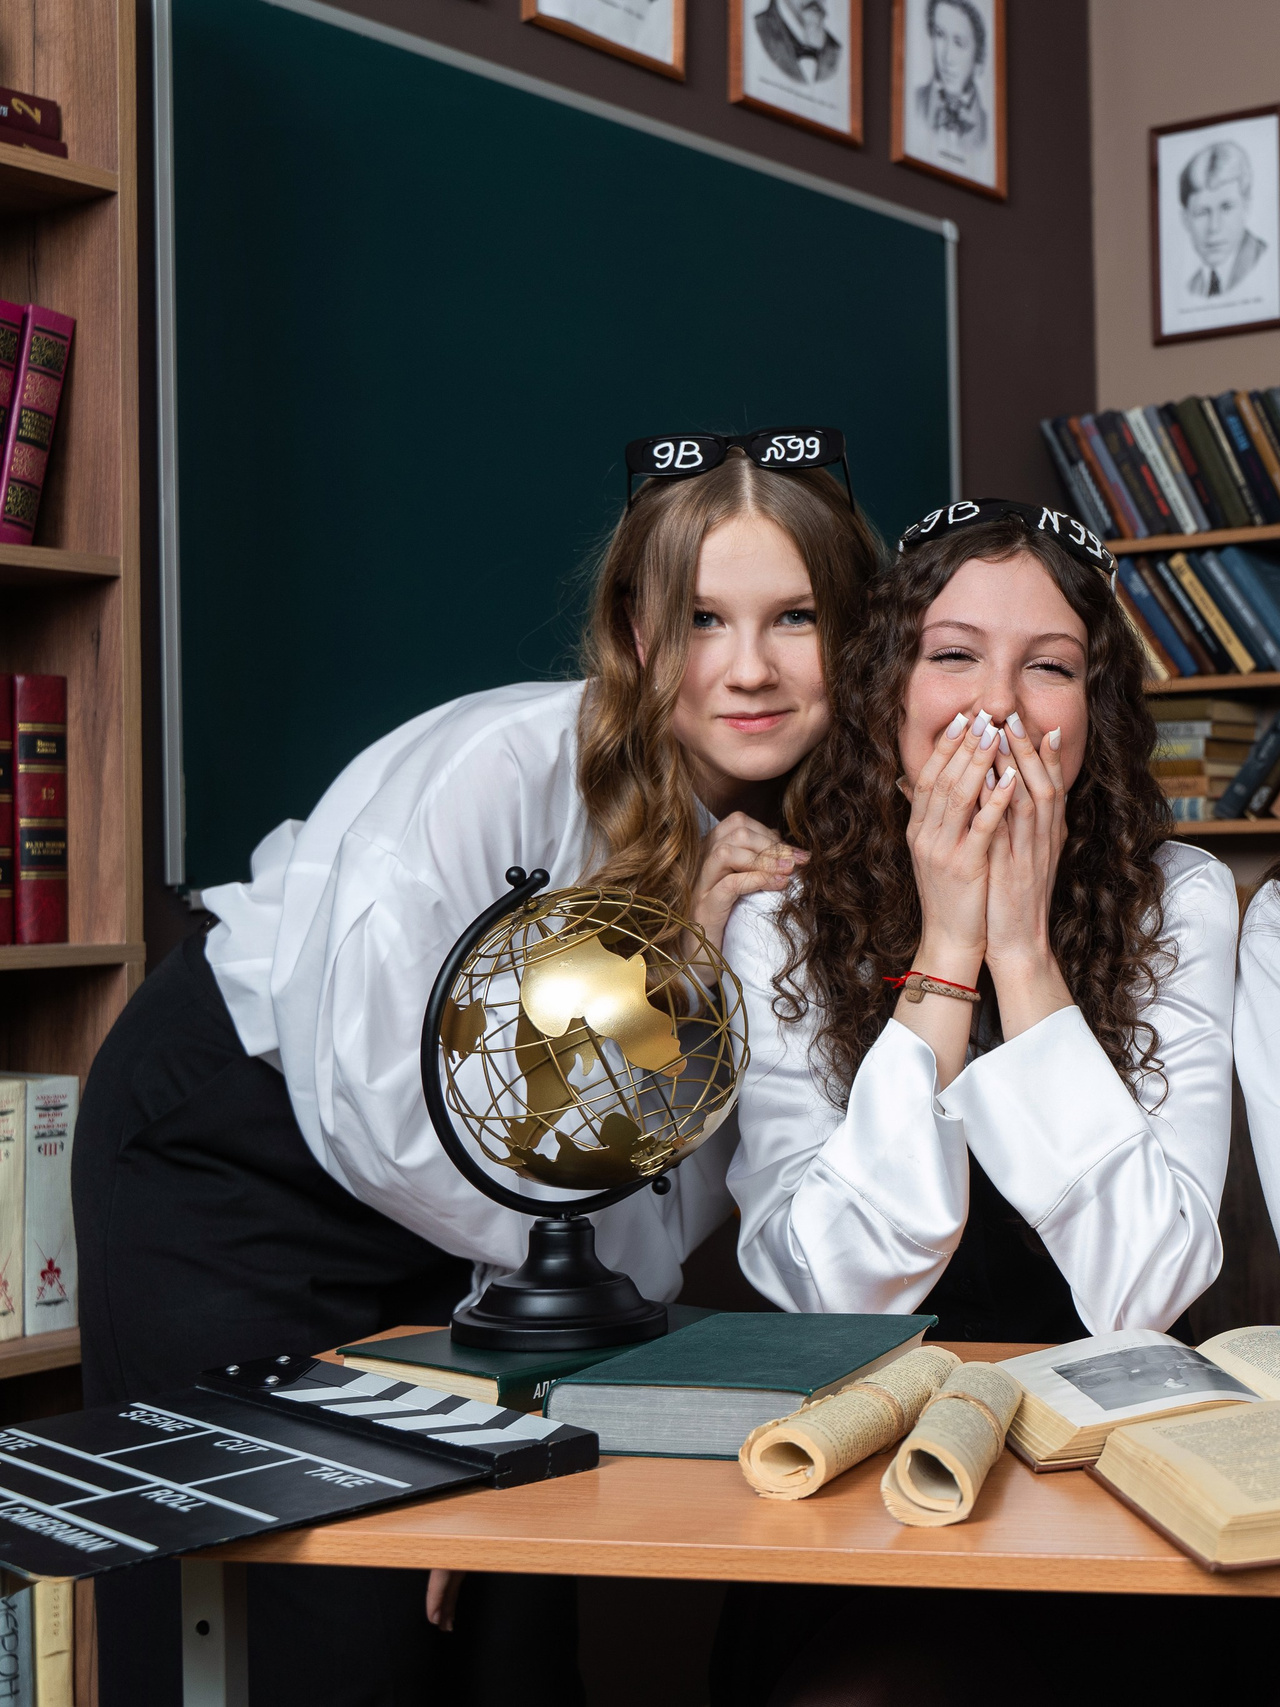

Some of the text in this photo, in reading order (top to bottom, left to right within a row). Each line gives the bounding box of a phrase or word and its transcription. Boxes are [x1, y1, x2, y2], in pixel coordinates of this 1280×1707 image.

[118, 1409, 195, 1433] SCENE
[212, 1438, 271, 1455] CUT
[303, 1465, 376, 1490] TAKE
[139, 1488, 208, 1514] ROLL
[0, 1505, 120, 1554] CAMERAMAN
